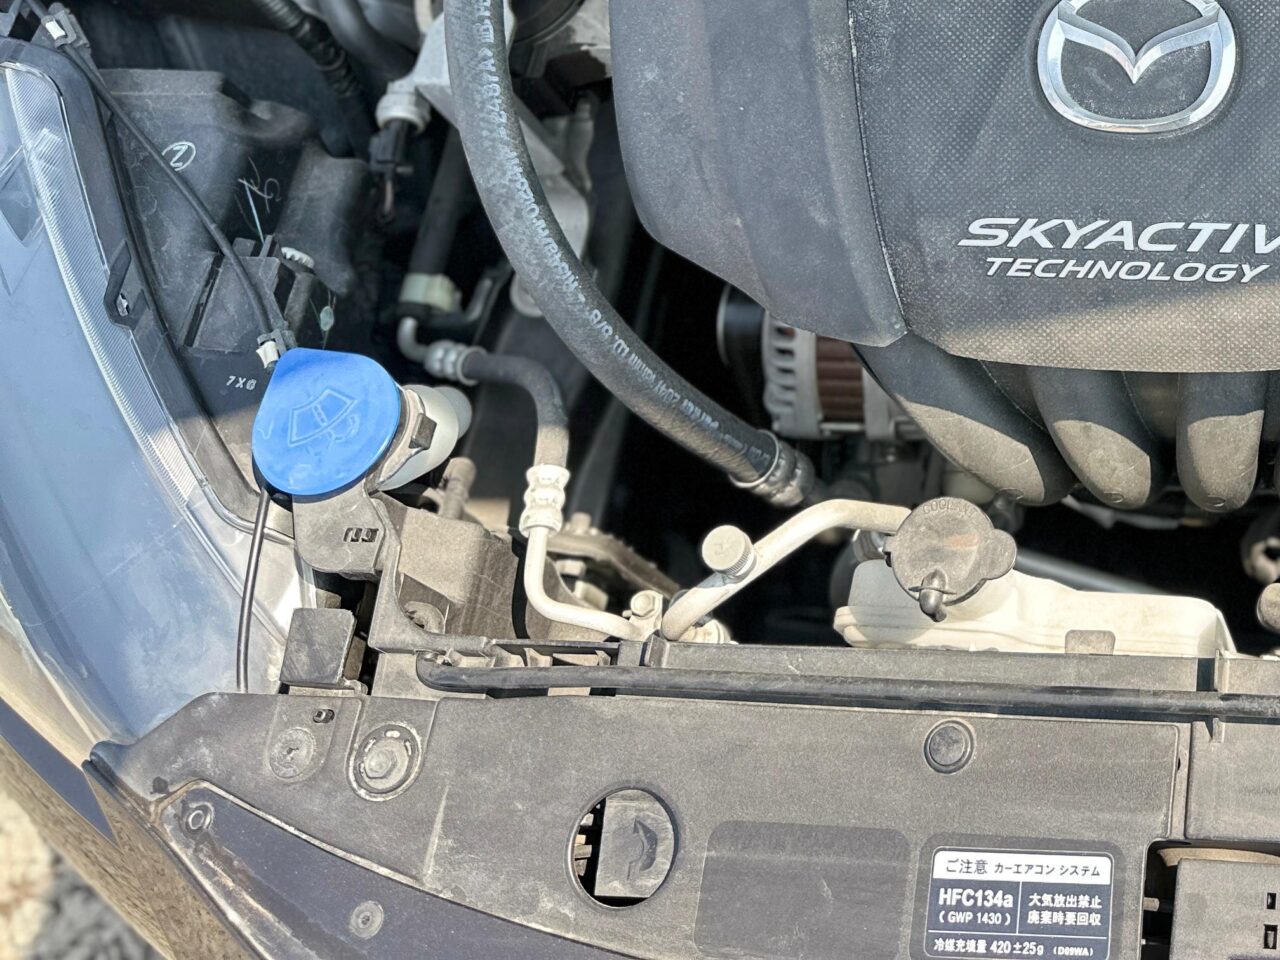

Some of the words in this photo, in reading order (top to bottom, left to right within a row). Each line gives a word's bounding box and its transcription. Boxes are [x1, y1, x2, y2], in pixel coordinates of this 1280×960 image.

[986, 257, 1271, 283] TECHNOLOGY
[946, 858, 988, 875] ご注意
[994, 862, 1055, 876] カーエアコン
[1059, 865, 1101, 877] システム
[938, 887, 1014, 908] HFC134a
[1028, 892, 1103, 909] 大気放出禁止
[1026, 911, 1102, 927] 廃棄時要回収
[933, 938, 987, 954] 冷媒充填量
